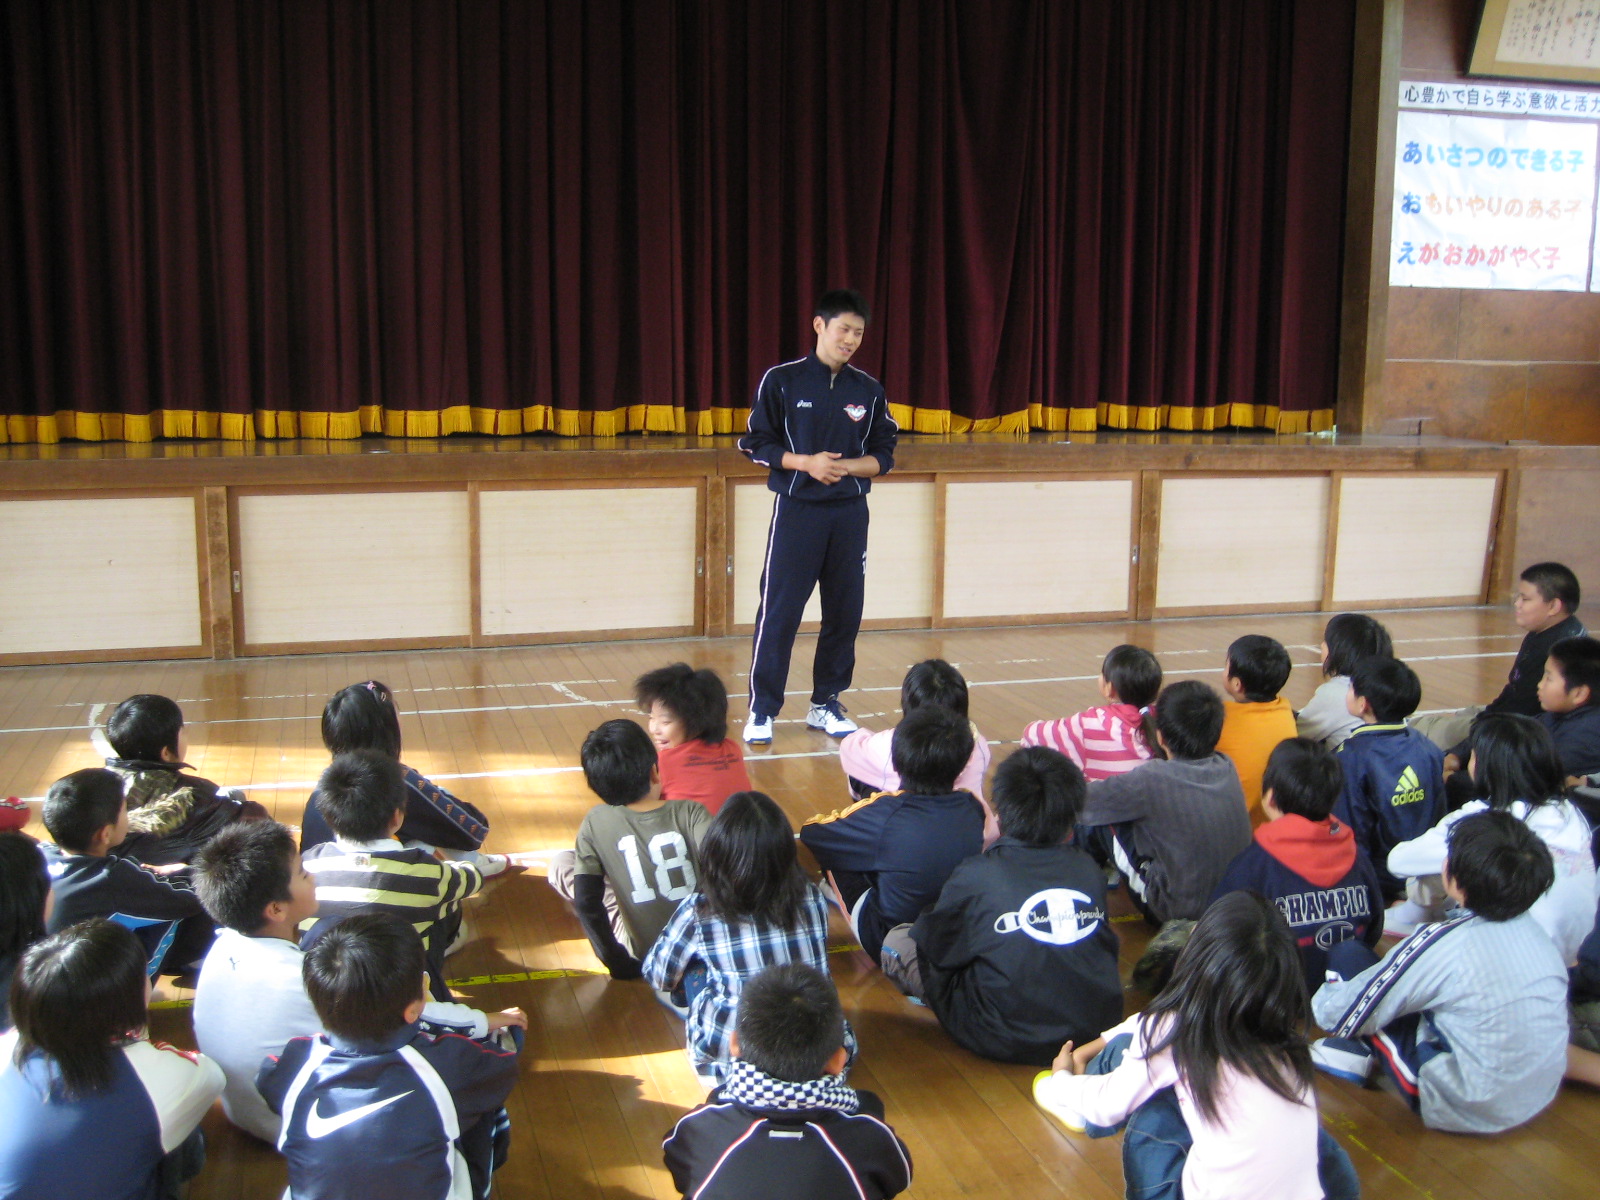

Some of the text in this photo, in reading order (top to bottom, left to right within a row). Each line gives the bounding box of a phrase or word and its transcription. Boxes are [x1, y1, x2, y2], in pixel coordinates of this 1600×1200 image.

[1402, 140, 1585, 173] あいさつのできる子
[1401, 191, 1582, 221] おもいやりのある子
[1397, 241, 1561, 270] えがおかがやく子
[1391, 788, 1424, 807] adidas
[617, 831, 697, 904] 18
[1275, 885, 1371, 927] CHAMPIO
